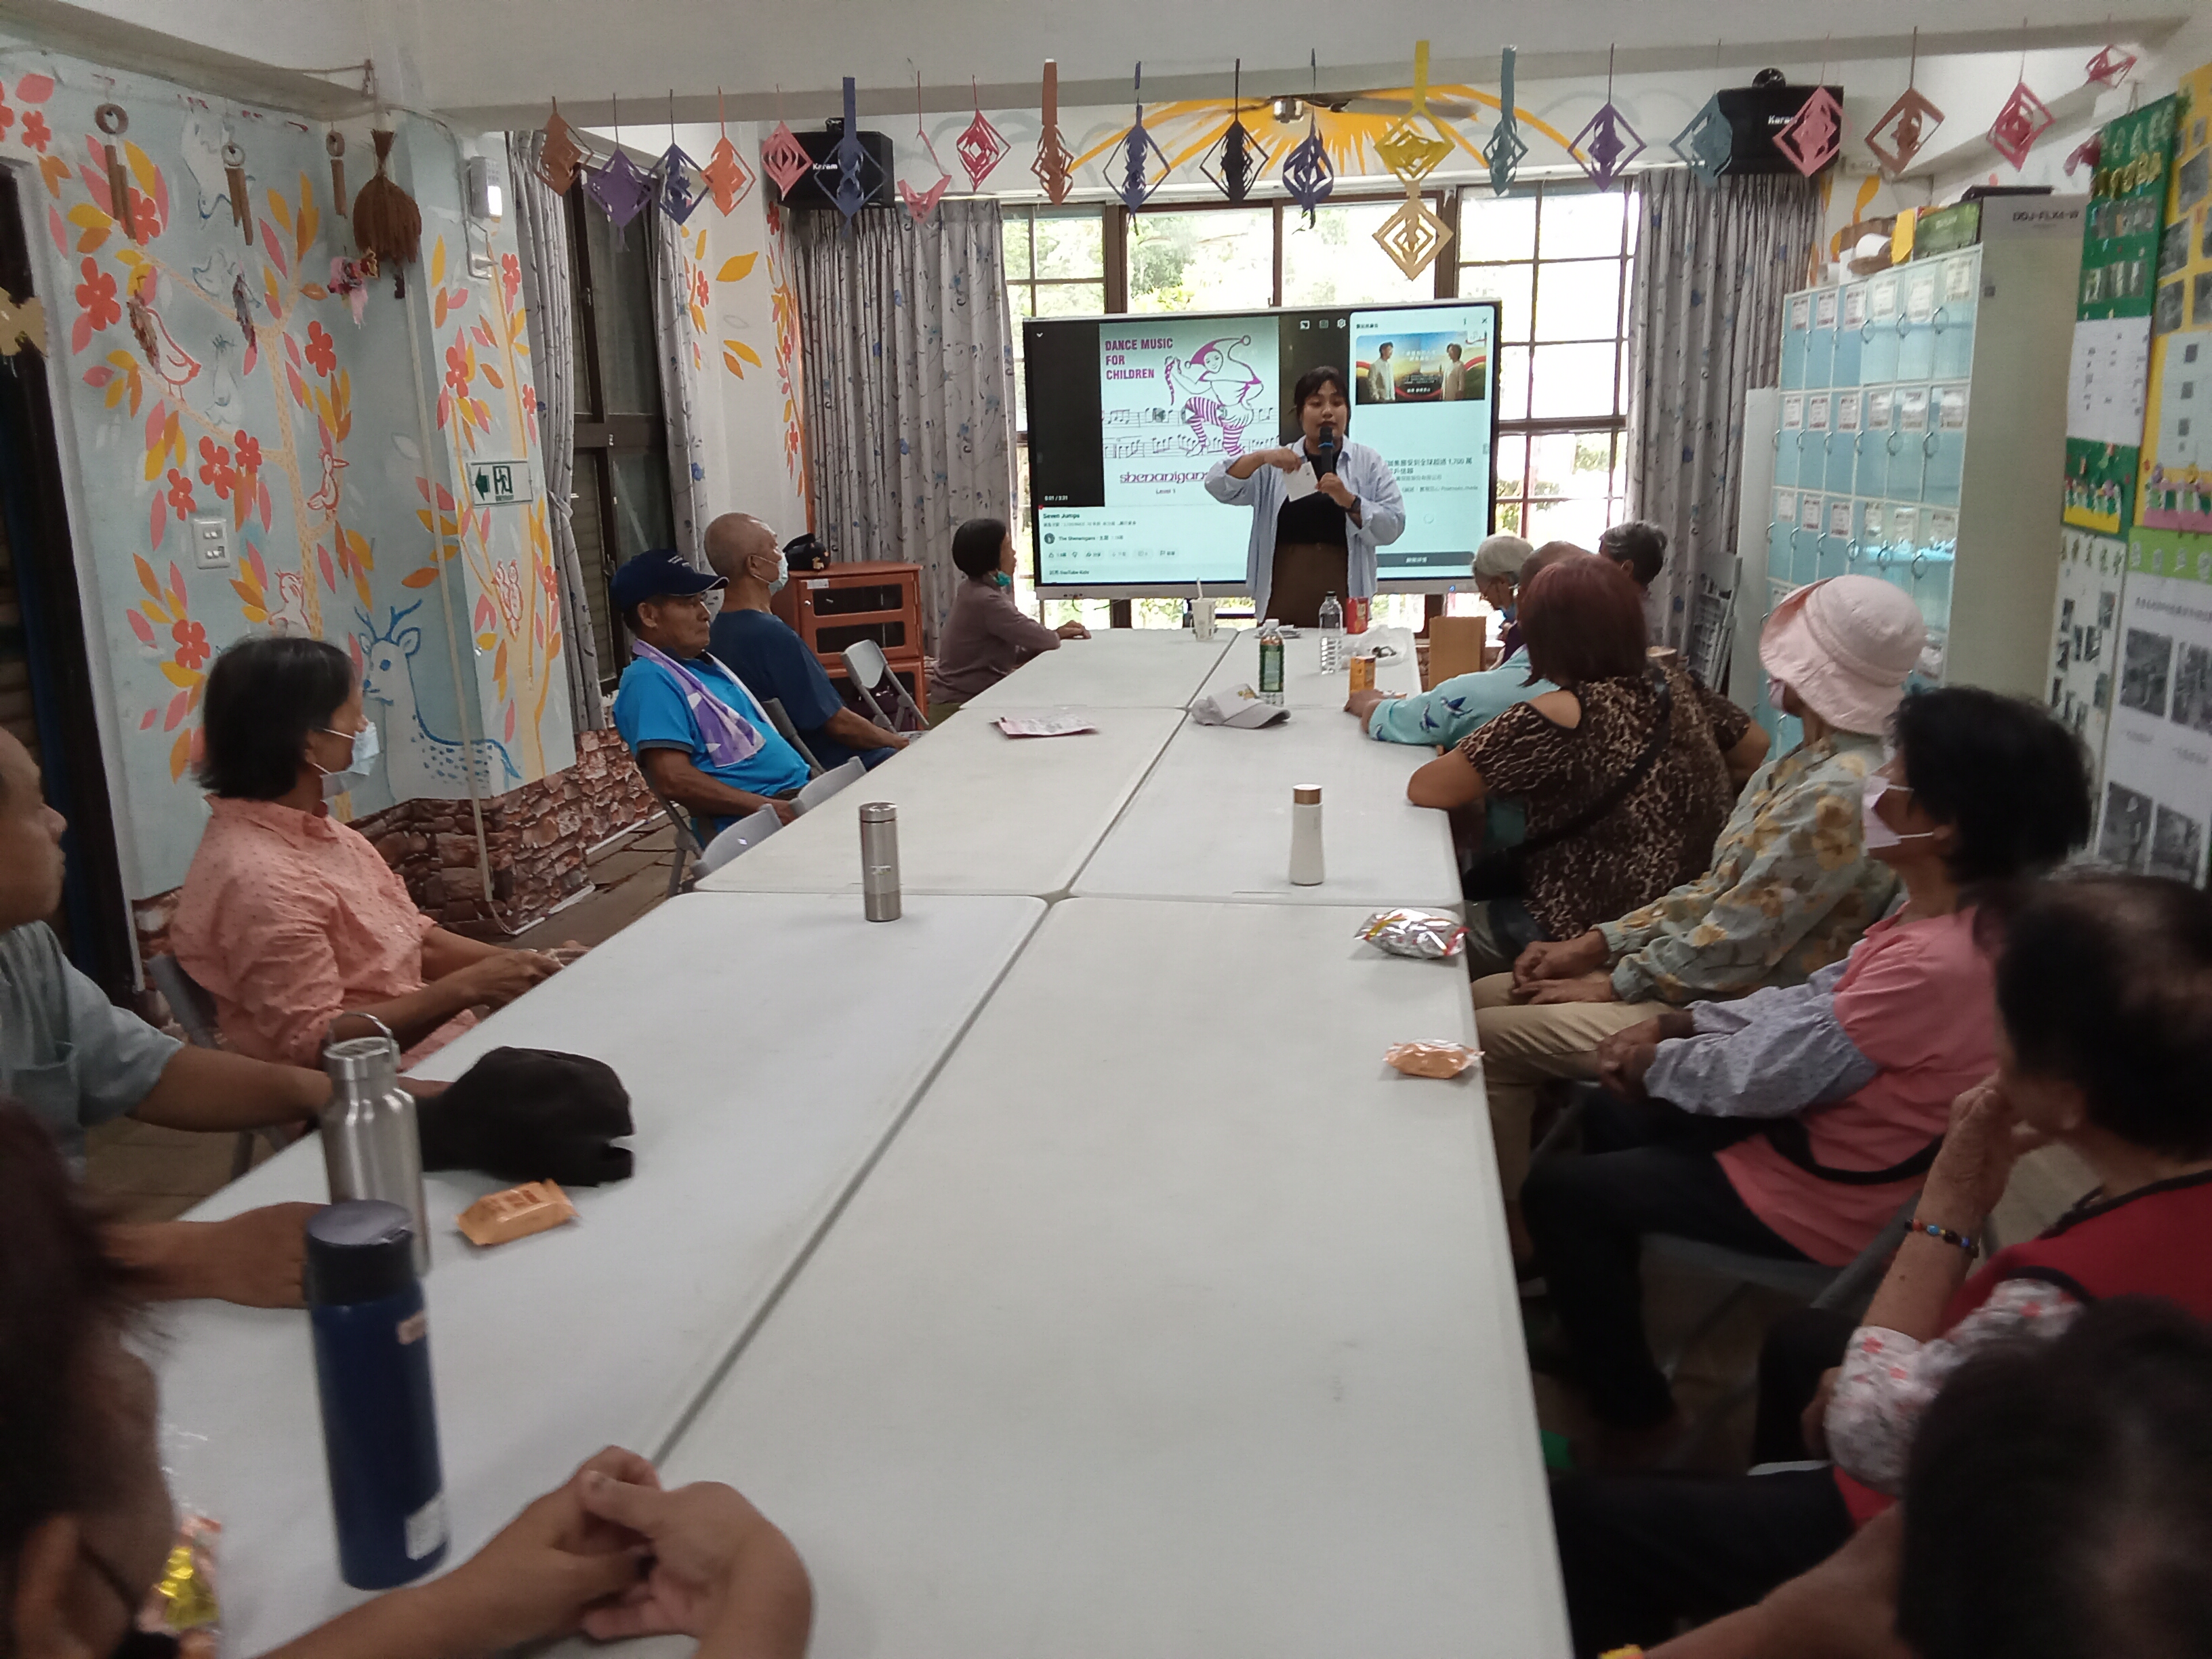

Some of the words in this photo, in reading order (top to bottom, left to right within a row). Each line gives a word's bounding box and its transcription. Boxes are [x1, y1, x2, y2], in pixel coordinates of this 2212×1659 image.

[1105, 339, 1137, 351] DANCE
[1141, 337, 1173, 350] MUSIC
[1105, 355, 1125, 366] FOR
[1106, 368, 1155, 380] CHILDREN
[1120, 471, 1208, 484] shenanigan
